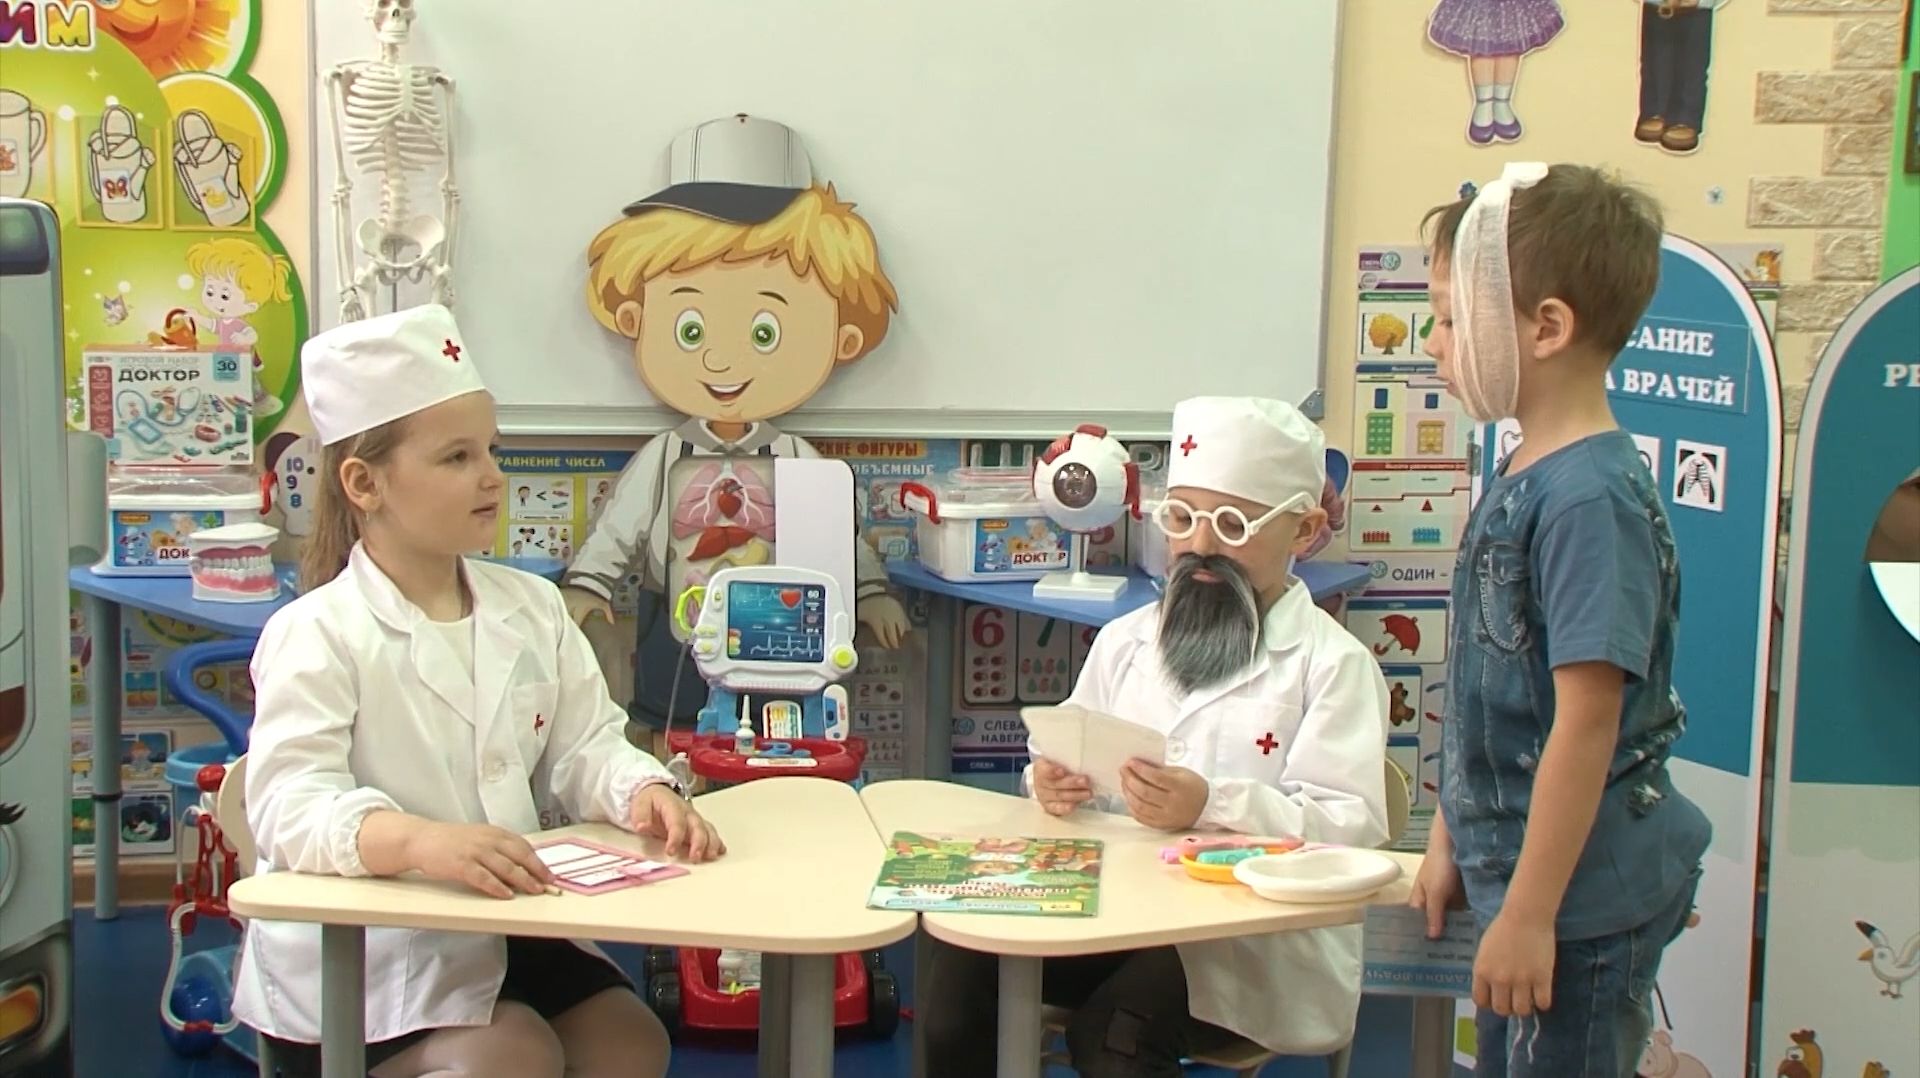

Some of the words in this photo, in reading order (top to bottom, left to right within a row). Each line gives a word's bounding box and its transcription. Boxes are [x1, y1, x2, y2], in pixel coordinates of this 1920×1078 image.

[217, 360, 237, 372] 30
[118, 368, 201, 383] ДОКТОР
[1623, 368, 1734, 405] ВРАЧЕЙ
[857, 441, 918, 457] ФИГУРЫ
[286, 457, 304, 473] 10
[565, 457, 606, 468] ЧИСЕЛ
[286, 475, 298, 490] 9
[290, 493, 303, 509] 8
[1013, 552, 1066, 565] ДОКТР
[1392, 568, 1435, 581] ОДИН
[972, 607, 1005, 649] 6
[984, 720, 1025, 732] СЛЕВА
